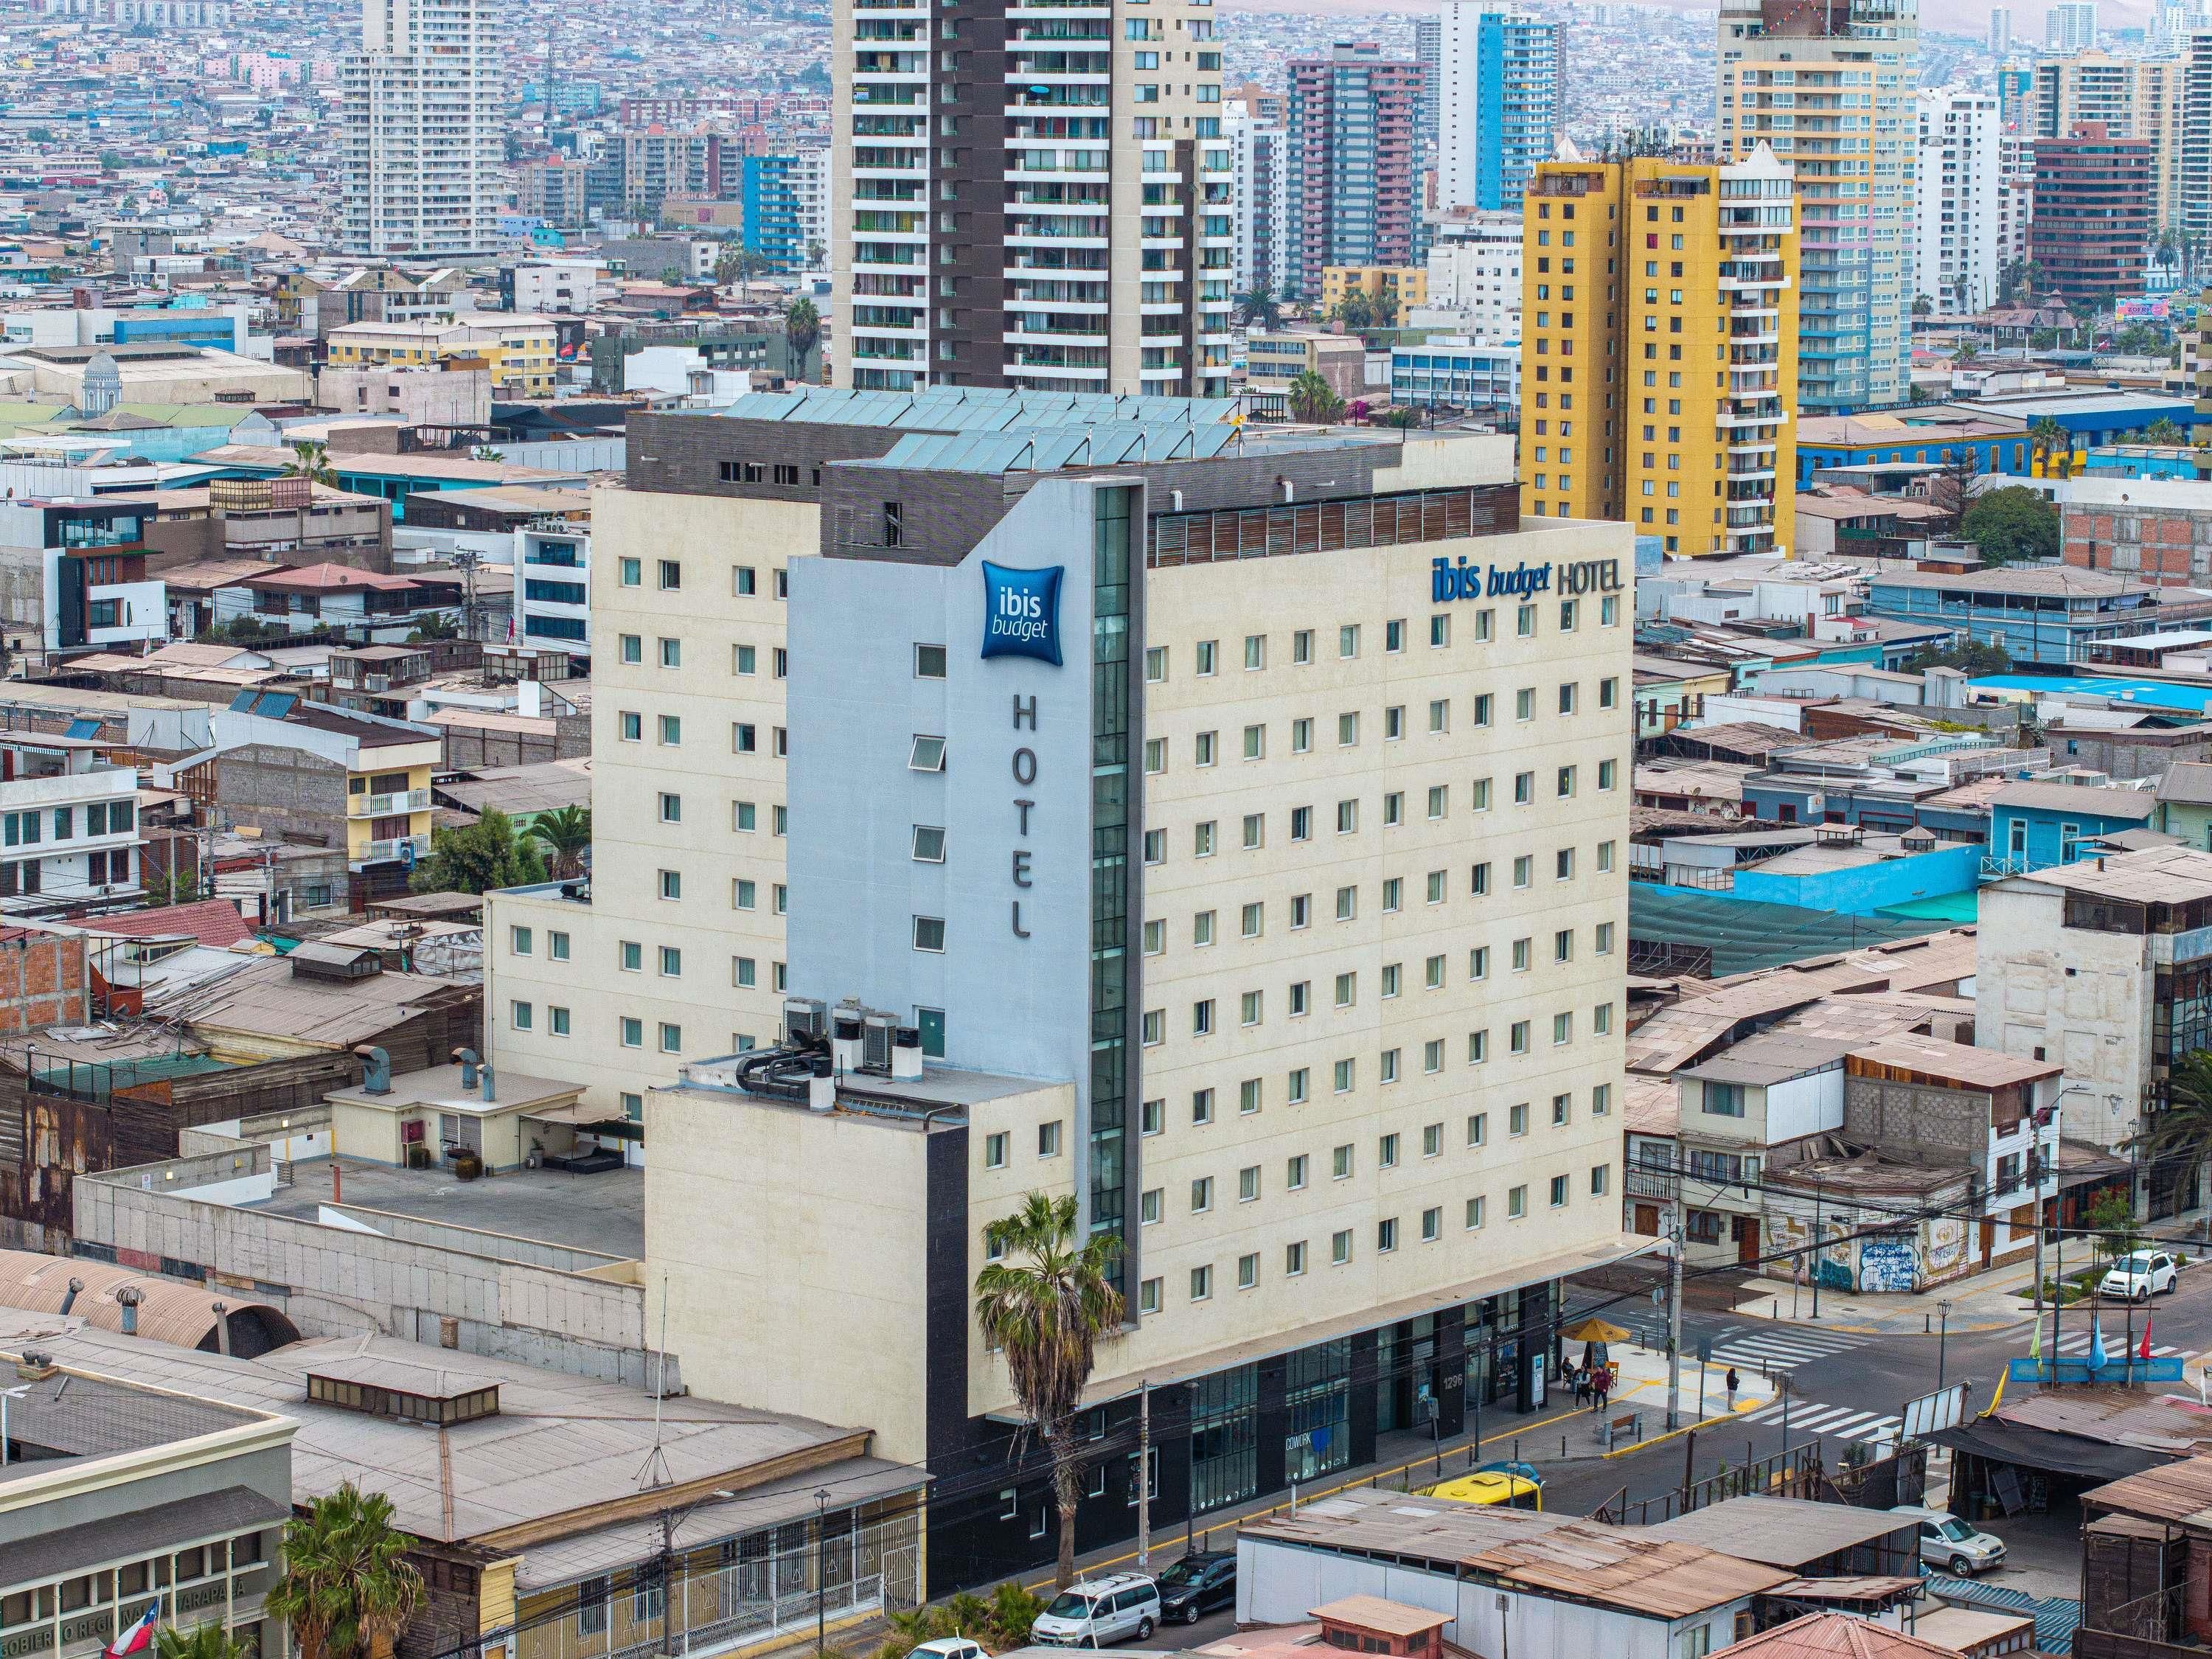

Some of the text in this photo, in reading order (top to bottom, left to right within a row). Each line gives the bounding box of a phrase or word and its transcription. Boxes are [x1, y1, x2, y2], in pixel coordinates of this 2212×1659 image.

[1432, 556, 1625, 602] ibis budget HOTEL
[1000, 586, 1041, 618] ibis
[992, 614, 1048, 641] budget
[1012, 694, 1037, 939] HOTEL
[1444, 1374, 1464, 1390] 1296
[1285, 1432, 1311, 1451] COWORK
[1, 1624, 74, 1657] GOBIERO
